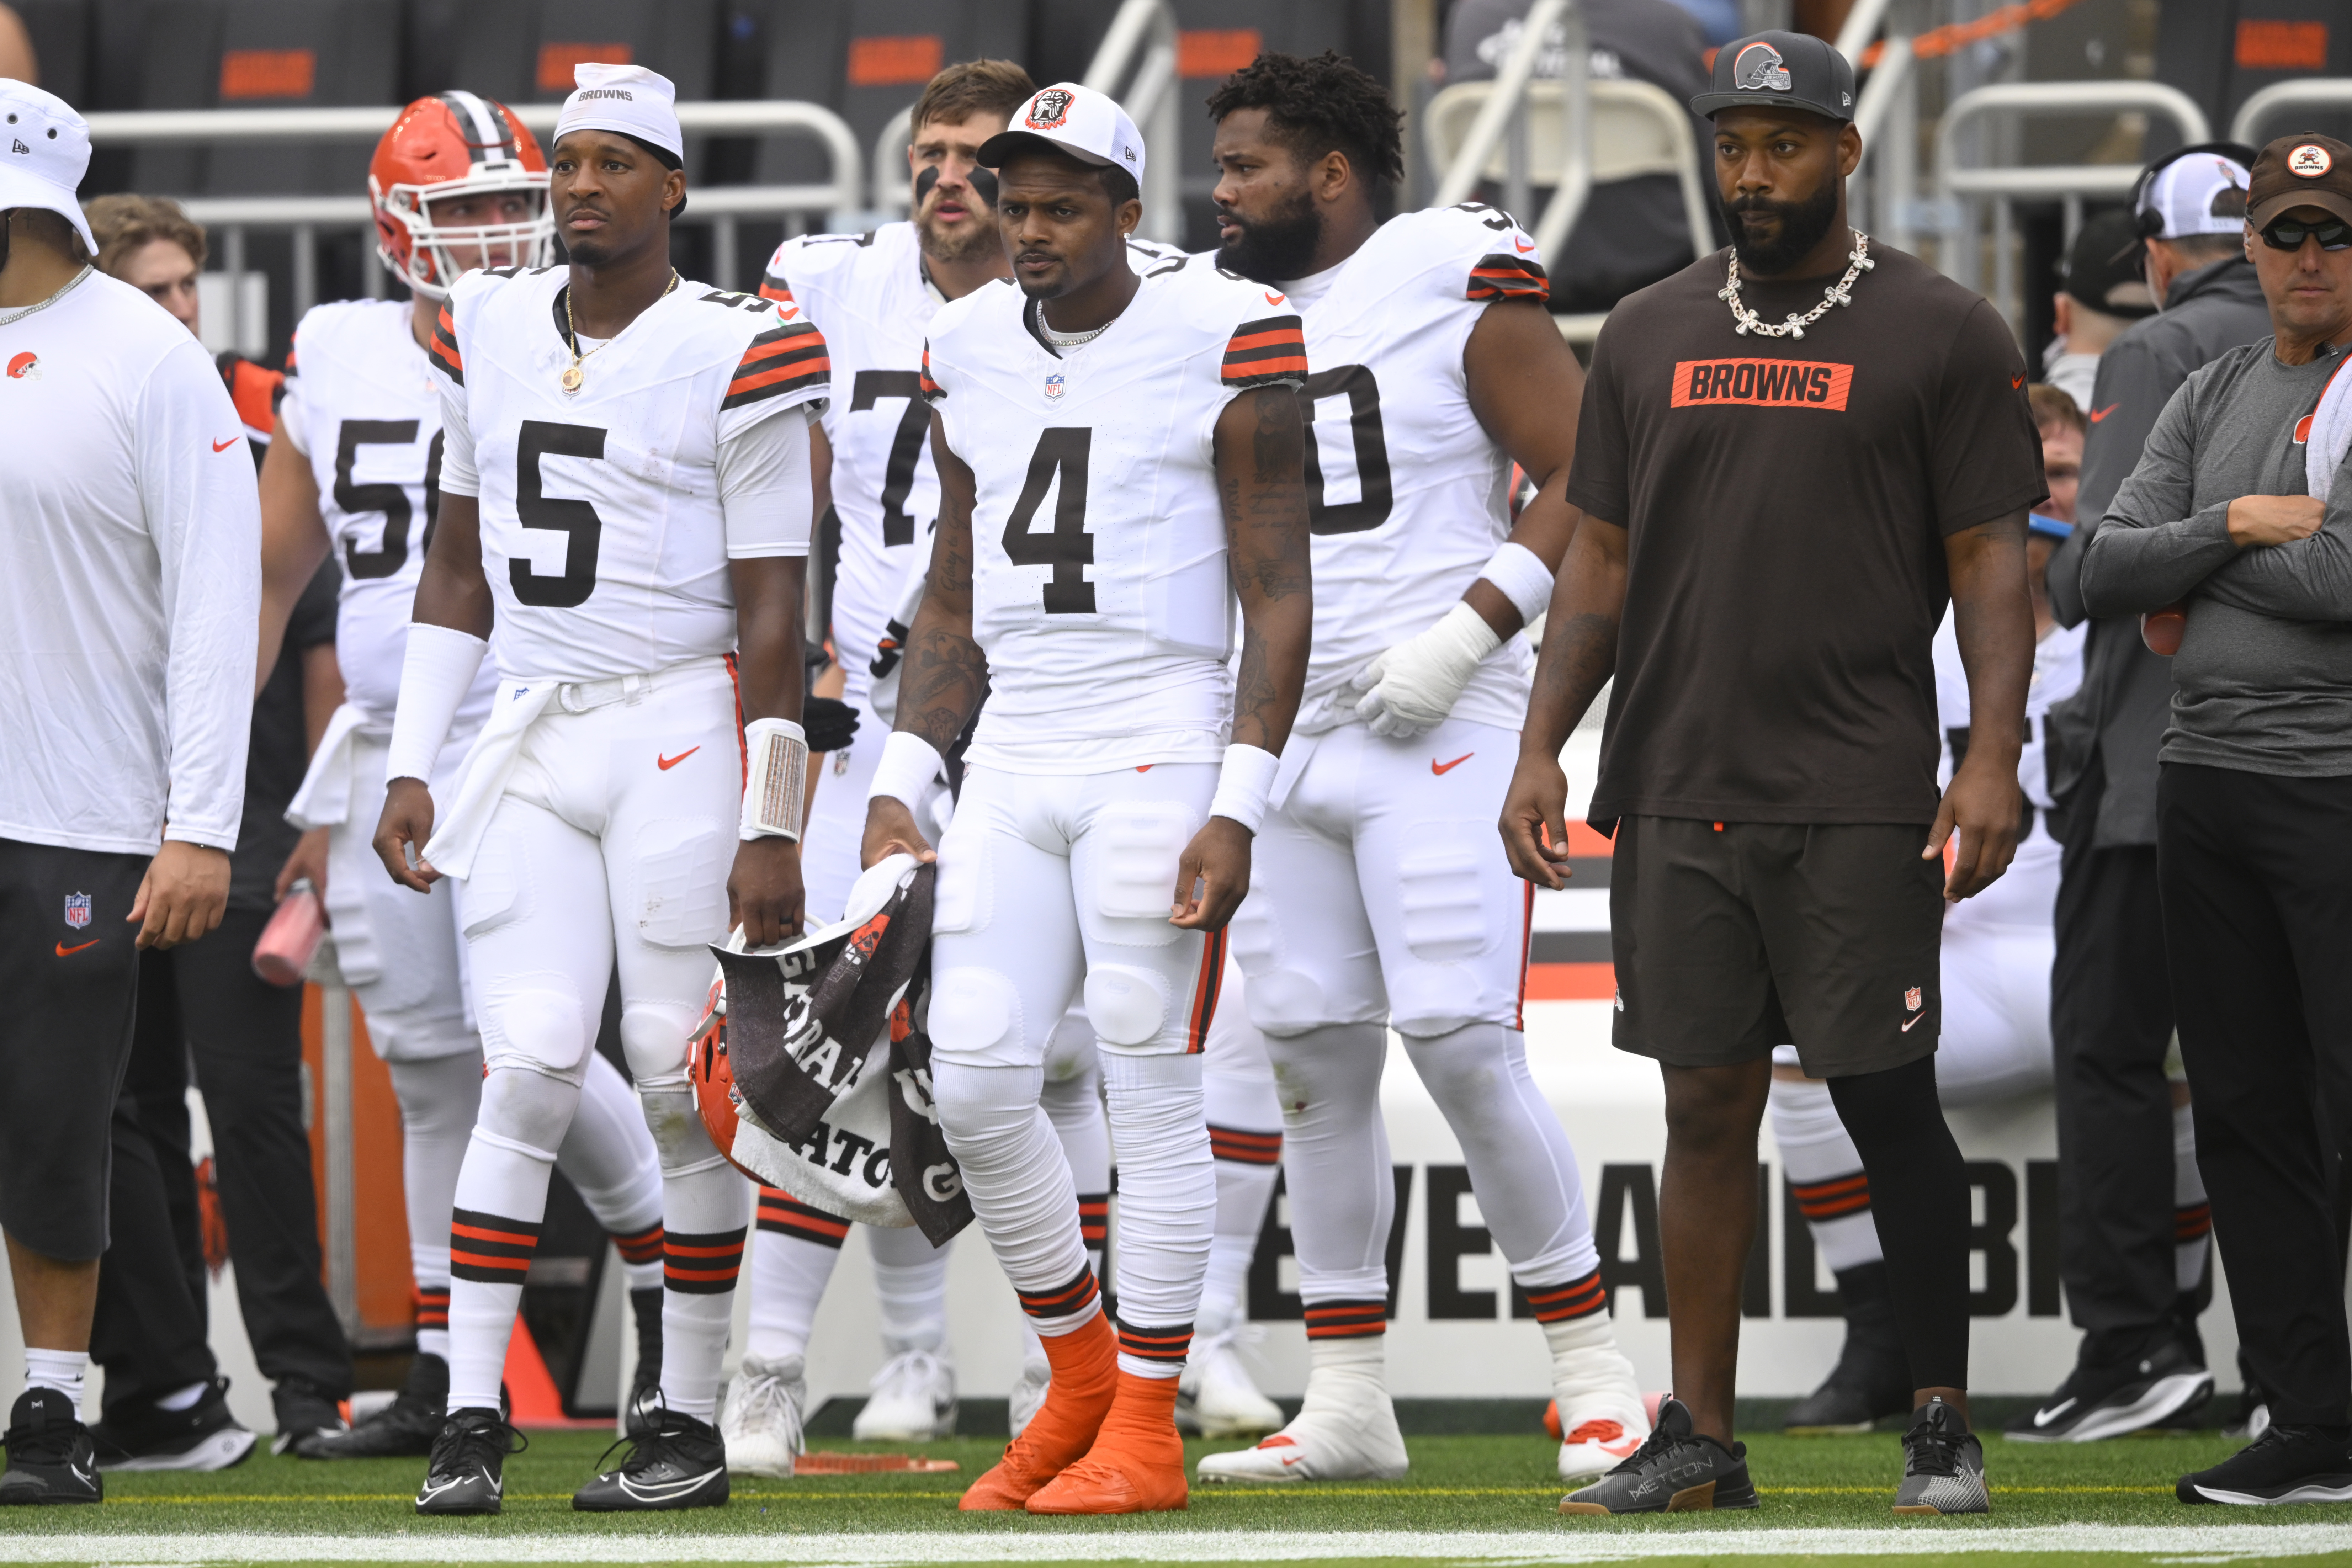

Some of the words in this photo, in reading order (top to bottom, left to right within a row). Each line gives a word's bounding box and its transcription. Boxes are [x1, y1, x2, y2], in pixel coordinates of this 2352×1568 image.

[578, 90, 633, 102] BROWNS
[1047, 384, 1062, 395] NFL
[1689, 363, 1832, 402] BROWNS
[509, 420, 608, 608] 5
[1001, 427, 1097, 614] 4
[69, 907, 89, 923] NFL
[1908, 996, 1920, 1007] NFL
[923, 1162, 963, 1202] G
[1629, 1456, 1713, 1502] METCON
